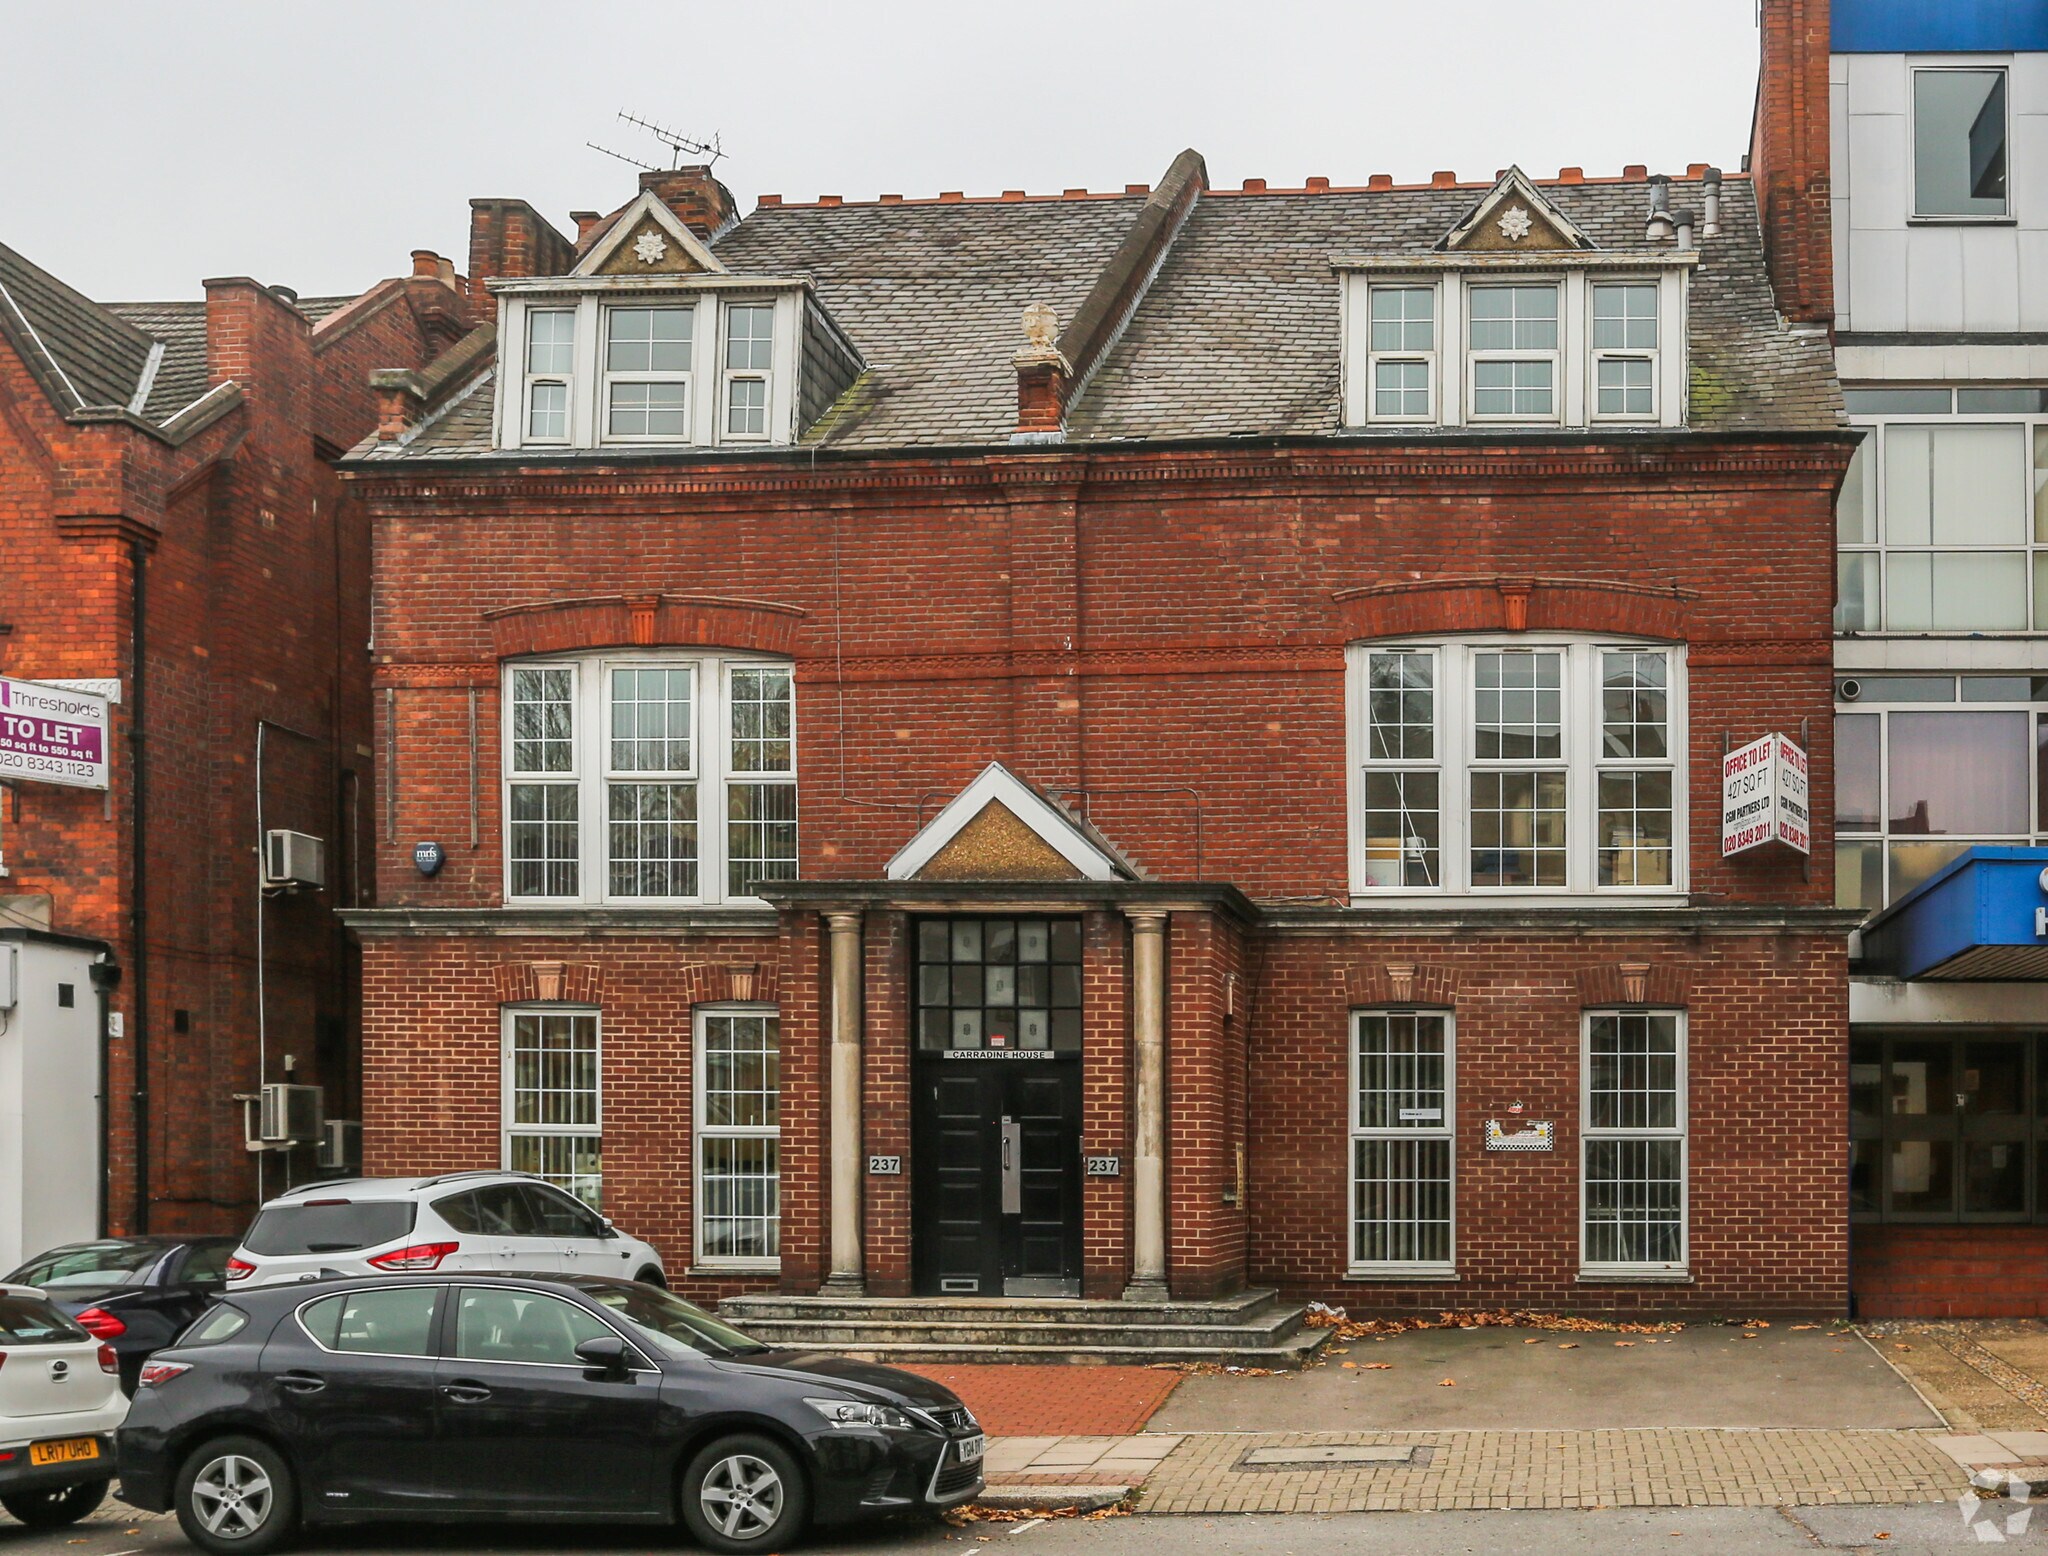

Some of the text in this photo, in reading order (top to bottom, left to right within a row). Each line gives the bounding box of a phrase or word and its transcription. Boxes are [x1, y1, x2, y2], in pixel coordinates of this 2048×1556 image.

[12, 690, 100, 718] Thresholds
[3, 716, 83, 746] TO LET
[15, 741, 27, 752] sq
[29, 741, 37, 752] ft
[39, 744, 49, 753] to
[51, 745, 69, 756] 550
[71, 749, 83, 760] sq
[85, 749, 94, 760] ft
[1724, 741, 1771, 778] OFFICE TO LET
[27, 757, 63, 774] 8343
[67, 762, 95, 778] 1123
[1727, 767, 1768, 800] 427 SQ FT
[1737, 799, 1761, 820] PARTNERS
[1761, 795, 1770, 811] LTD
[1724, 834, 1736, 853] 020
[1737, 827, 1754, 848] 8349
[1754, 820, 1771, 842] 2011
[416, 847, 437, 858] mrfs
[952, 1051, 1045, 1059] CARRADINE HOUSE
[871, 1158, 899, 1171] 237
[1089, 1159, 1117, 1172] 237
[37, 1443, 65, 1462] LR17
